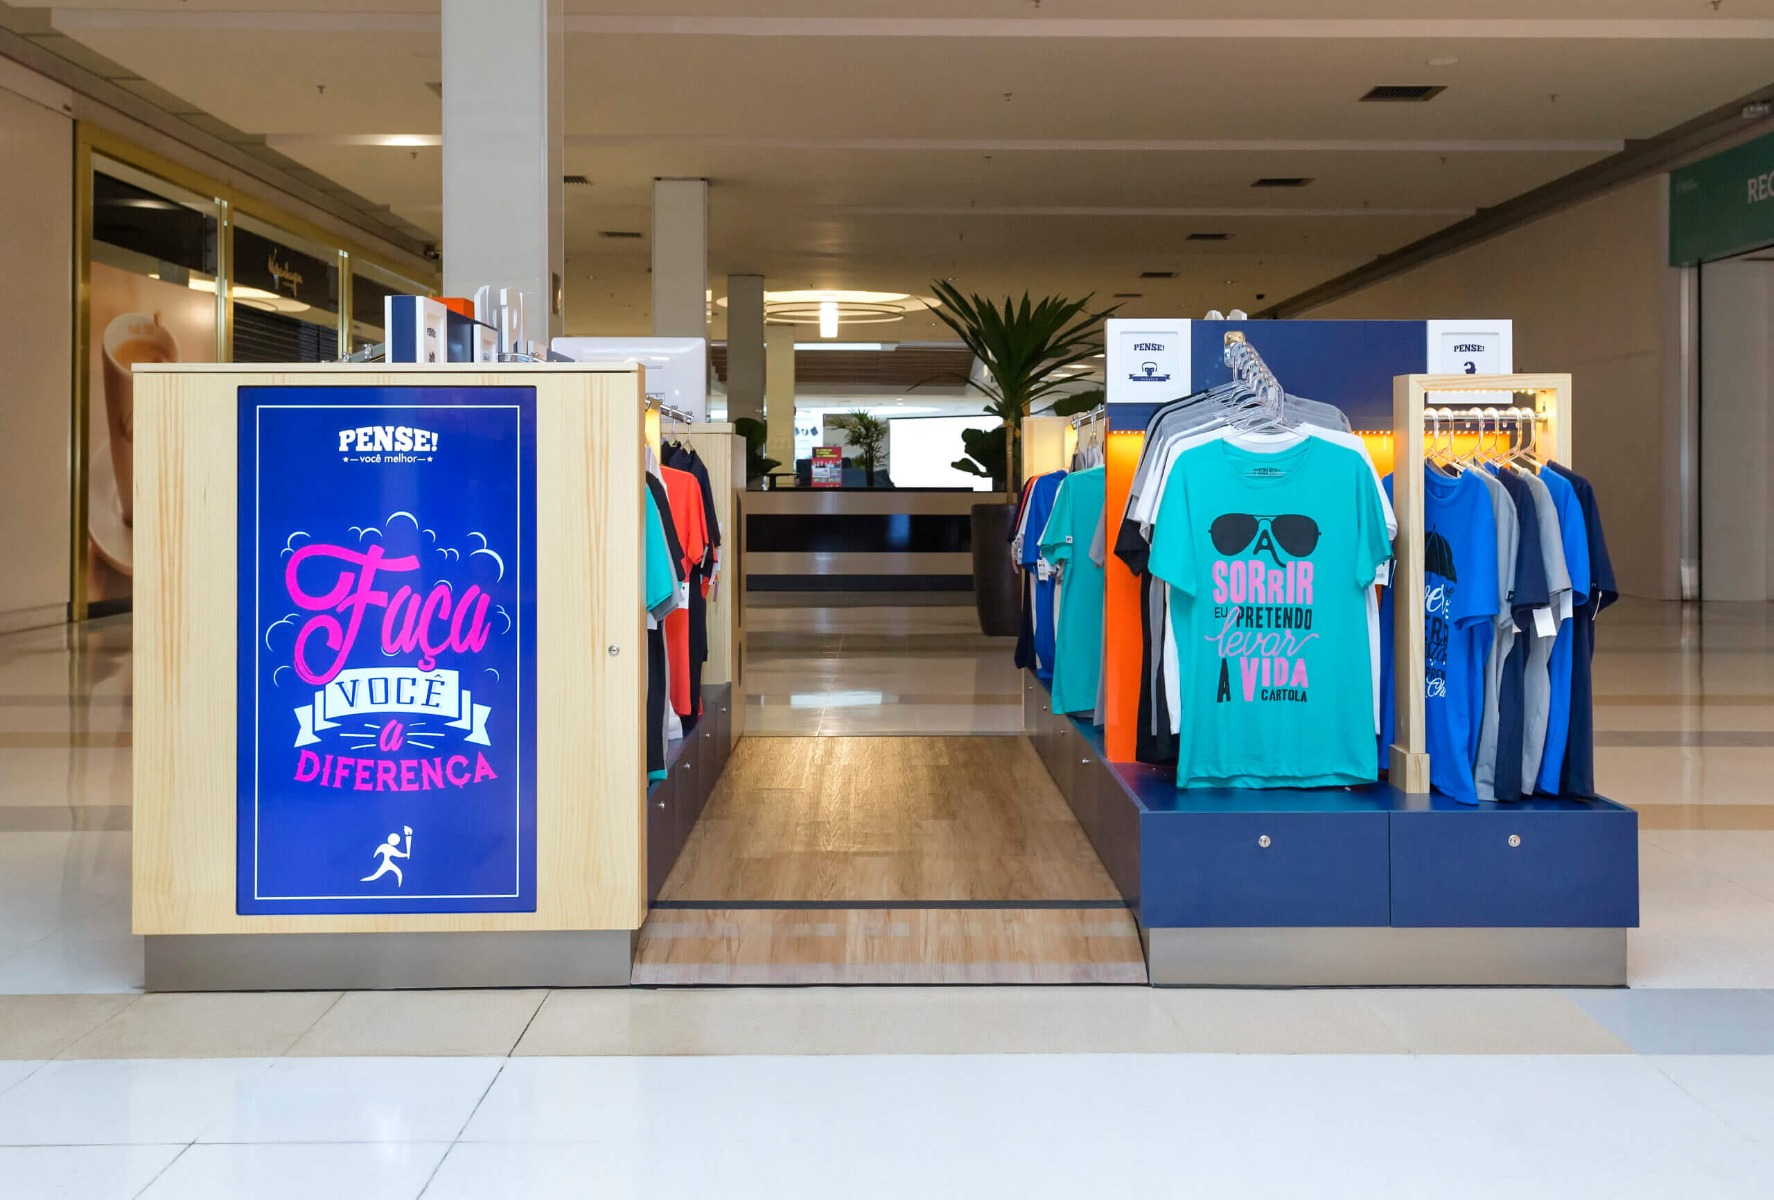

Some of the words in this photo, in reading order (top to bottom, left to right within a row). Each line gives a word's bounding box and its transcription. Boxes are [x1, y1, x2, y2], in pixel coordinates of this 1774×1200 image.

[1133, 342, 1165, 352] PENSE!
[1453, 343, 1485, 353] PENSE!
[338, 425, 439, 452] PENSE!
[360, 453, 382, 463] você
[384, 452, 417, 463] melhor
[286, 544, 491, 685] Faça
[1214, 606, 1228, 619] EU
[1236, 605, 1313, 630] PRETENDO
[1204, 606, 1320, 657] levar
[335, 674, 446, 709] VOCÊ
[1216, 657, 1231, 703] A
[1240, 656, 1309, 702] VIDA
[1261, 688, 1308, 703] CARTOLA
[379, 719, 404, 752] a
[294, 749, 498, 792] DIFERENÇA
